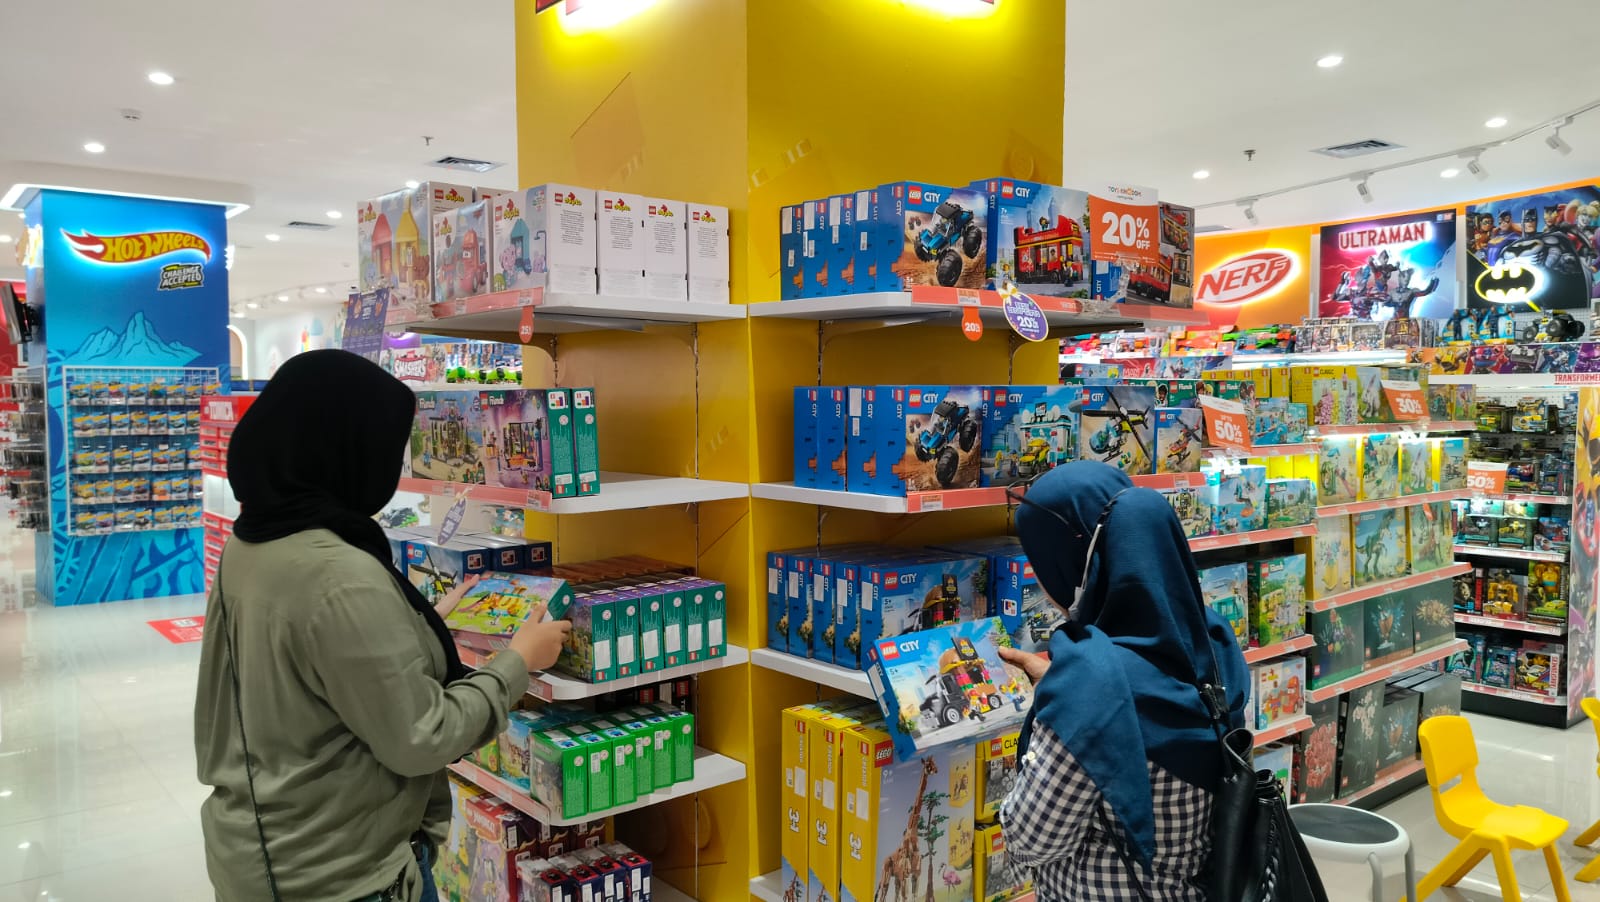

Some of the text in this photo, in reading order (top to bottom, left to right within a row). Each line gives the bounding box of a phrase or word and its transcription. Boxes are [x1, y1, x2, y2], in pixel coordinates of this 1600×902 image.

[924, 191, 941, 203] CITY
[1015, 187, 1030, 197] CITY
[1102, 212, 1150, 247] 20%
[1136, 240, 1151, 249] OFF
[163, 266, 200, 279] CHALLENGE
[1196, 255, 1288, 300] NERF
[162, 274, 201, 287] ACCEPTED
[1017, 316, 1039, 329] 20%
[923, 393, 939, 403] CITY
[1008, 394, 1023, 403] CITY
[1091, 393, 1104, 402] CITY
[900, 572, 917, 584] CITY
[900, 640, 919, 653] CITY
[876, 749, 892, 760] LEGO
[883, 769, 892, 777] 9+
